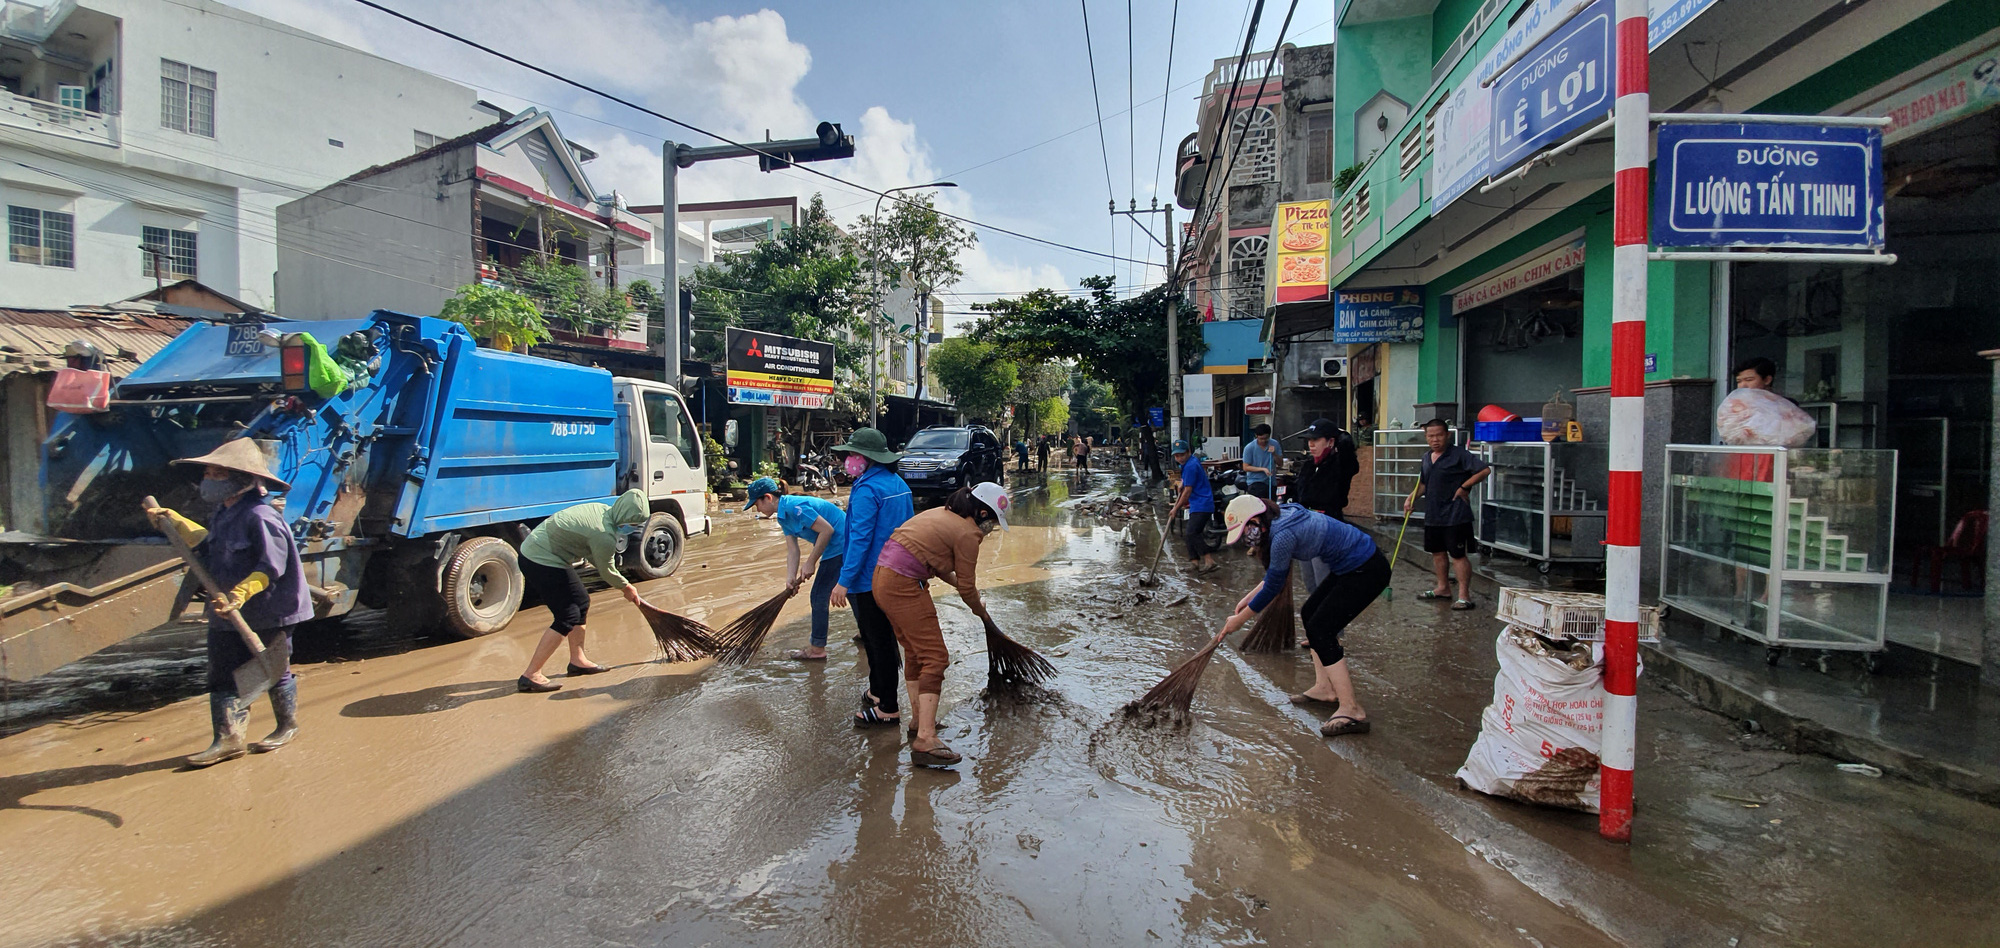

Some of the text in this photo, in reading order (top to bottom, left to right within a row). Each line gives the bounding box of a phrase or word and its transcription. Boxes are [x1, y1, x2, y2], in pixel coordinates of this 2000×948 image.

[1521, 47, 1569, 91] ĐƯỜNG
[1500, 59, 1596, 146] LÊ LỢI
[1737, 145, 1819, 167] ĐƯỜNG
[1684, 171, 1856, 217] LƯƠNG TẤN THINH
[1285, 207, 1328, 221] Pizza
[1458, 292, 1474, 309] BÁN
[1476, 286, 1488, 301] CÁ
[1489, 277, 1516, 299] CẢNH
[1523, 261, 1552, 283] CHIM
[1339, 292, 1395, 304] PHONG
[1339, 305, 1356, 329] BÁN
[1359, 306, 1390, 317] CÁ CẢNH
[1359, 319, 1377, 328] CHIM
[235, 326, 258, 340] 78B
[230, 341, 260, 354] 0750
[764, 345, 819, 360] MITSUBISHI
[764, 362, 820, 375] AIR CONDITIONERS
[1552, 700, 1568, 710] HỢP
